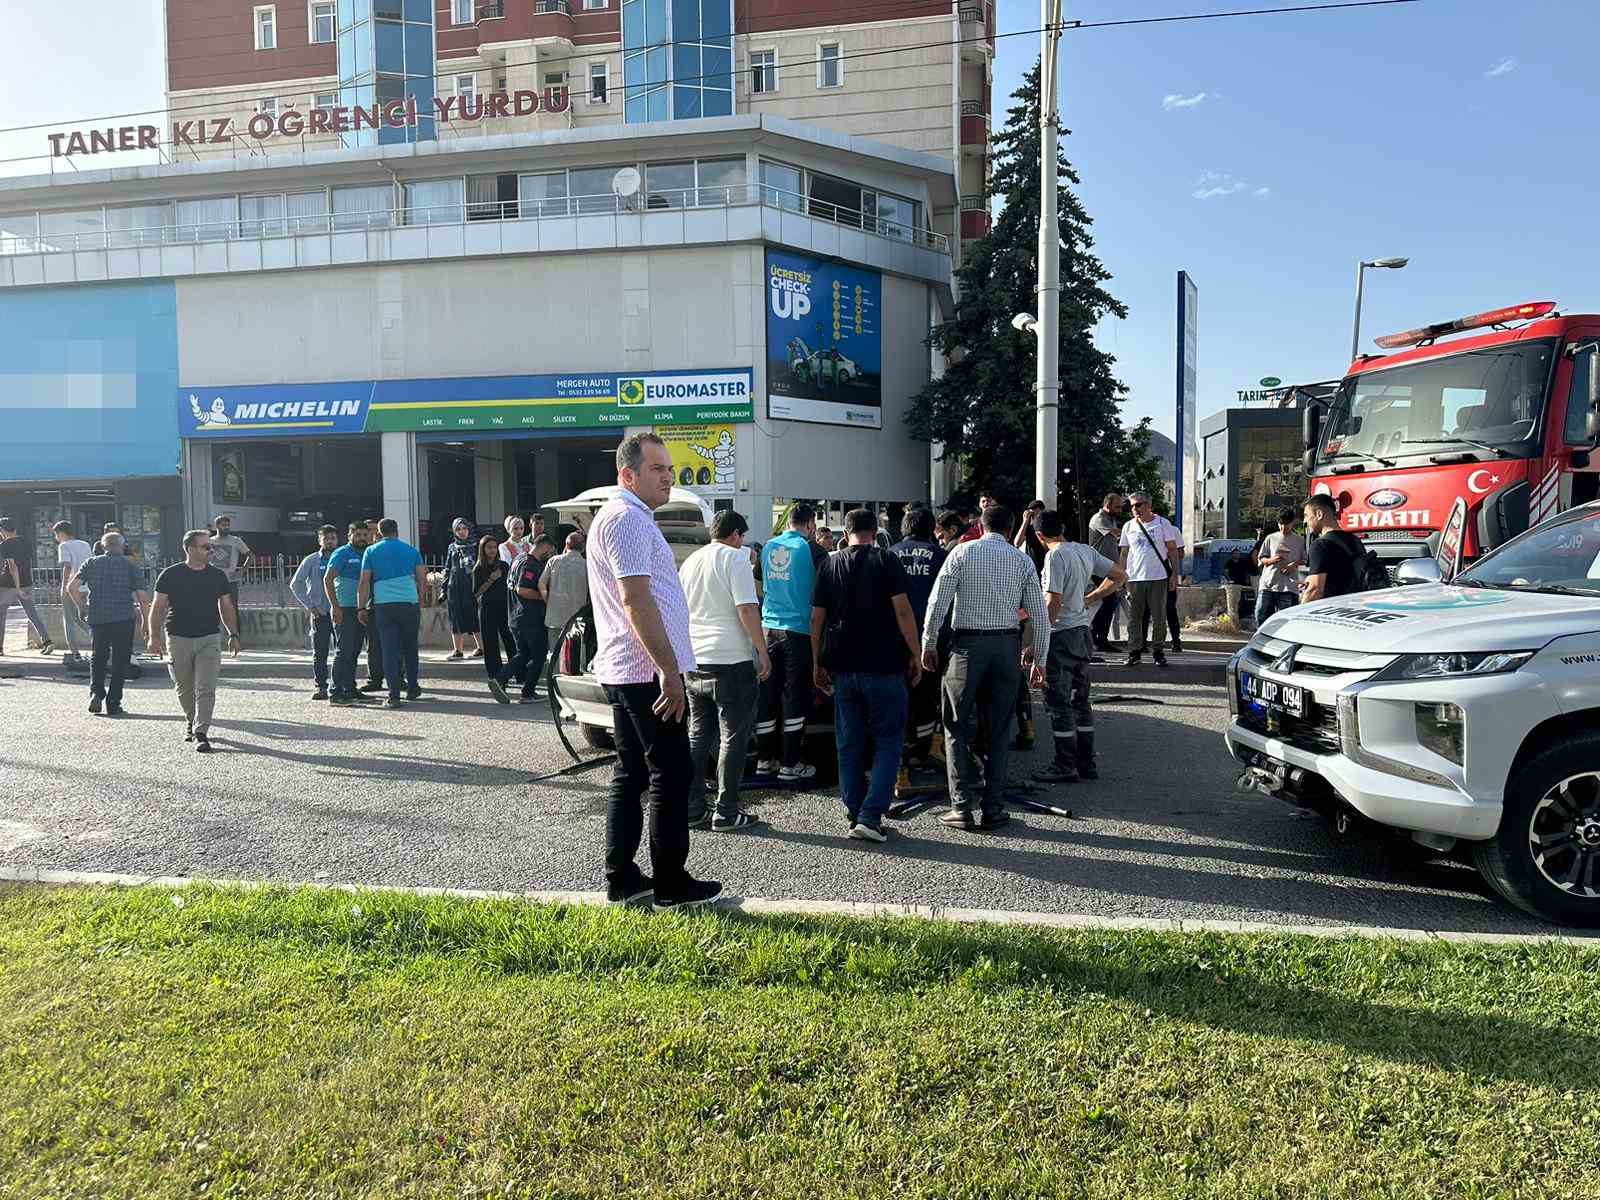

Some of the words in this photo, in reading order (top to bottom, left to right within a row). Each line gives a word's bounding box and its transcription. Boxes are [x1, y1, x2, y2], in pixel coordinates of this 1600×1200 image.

[48, 125, 158, 157] TANER
[173, 118, 232, 146] KIZ
[248, 92, 417, 139] ÖĞRENCİ
[433, 86, 571, 123] YURDU
[770, 263, 812, 284] ÜCRETSİZ
[771, 287, 811, 321] UP
[556, 379, 588, 389] MERGEN
[589, 378, 611, 388] AUTO
[646, 381, 746, 399] EUROMASTER
[1236, 390, 1268, 402] TARIM
[233, 399, 361, 420] MICHELIN
[598, 413, 608, 422] ÖN
[609, 413, 630, 422] DÜZEN
[458, 417, 474, 425] FREN
[521, 415, 535, 424] AKÜ
[1309, 605, 1408, 624] UMKE
[1246, 676, 1258, 696] 44
[1260, 680, 1278, 702] ADP
[1282, 686, 1300, 711] 094
